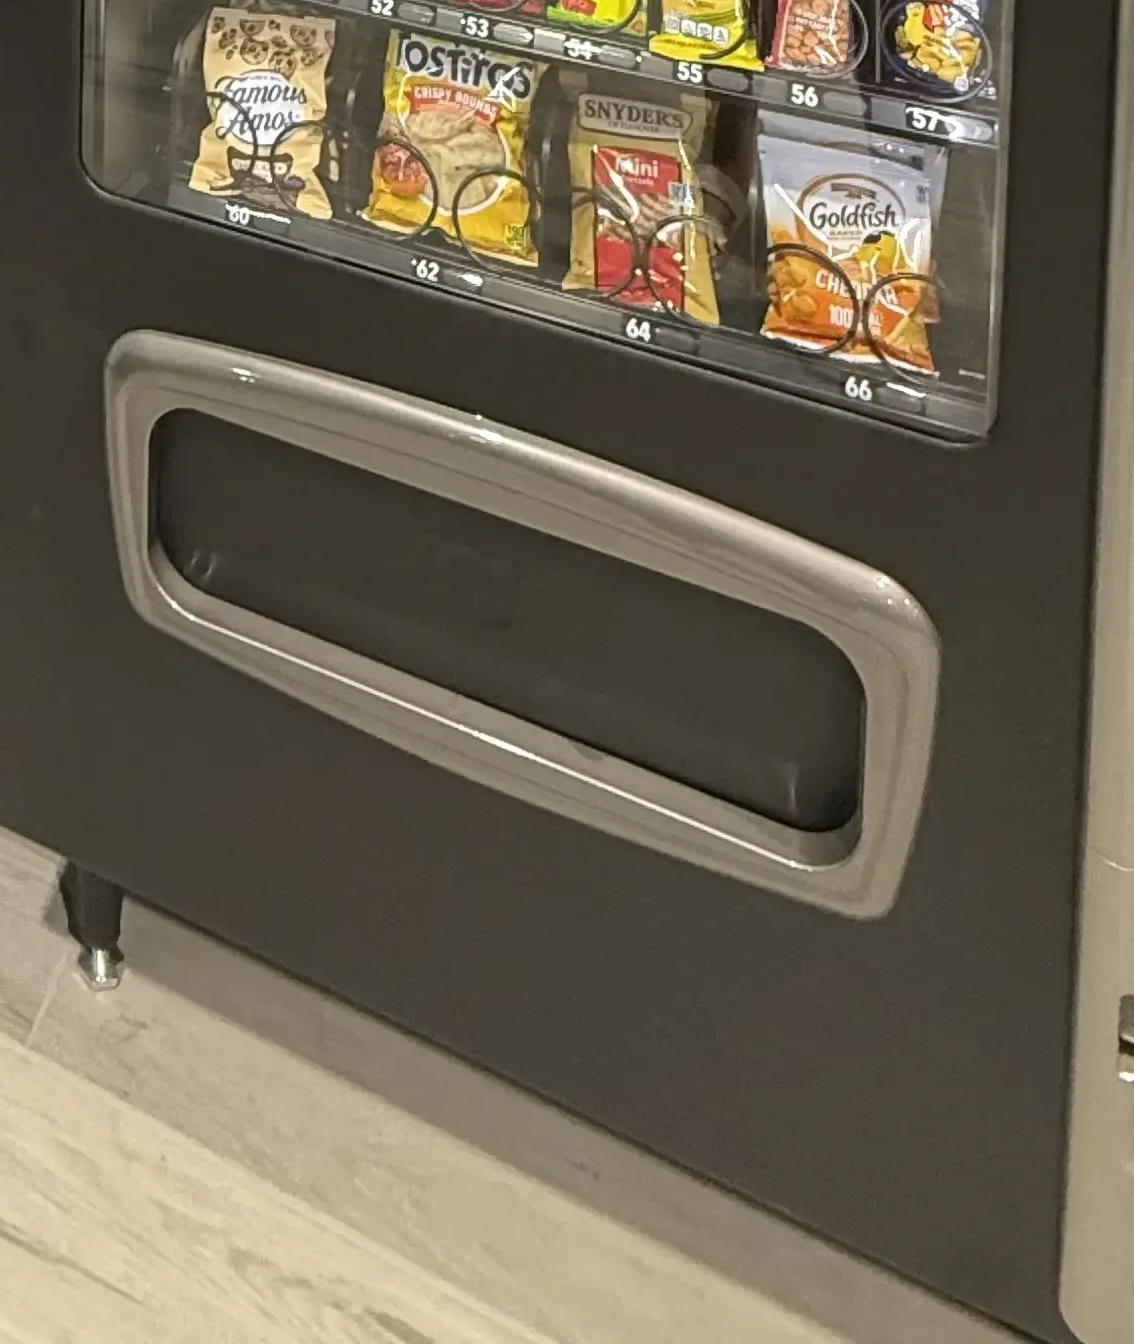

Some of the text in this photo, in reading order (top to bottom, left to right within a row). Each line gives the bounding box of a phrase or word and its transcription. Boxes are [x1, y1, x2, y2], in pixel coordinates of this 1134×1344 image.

[466, 19, 489, 37] 53
[677, 65, 703, 85] 55
[215, 75, 308, 109] Famous
[414, 86, 453, 103] CRISPY
[791, 85, 819, 106] 56
[215, 106, 294, 140] Amos
[911, 109, 939, 131] 57
[809, 201, 898, 231] Goldfish
[415, 258, 441, 282] 62
[625, 320, 652, 342] 64
[843, 378, 873, 401] 66
